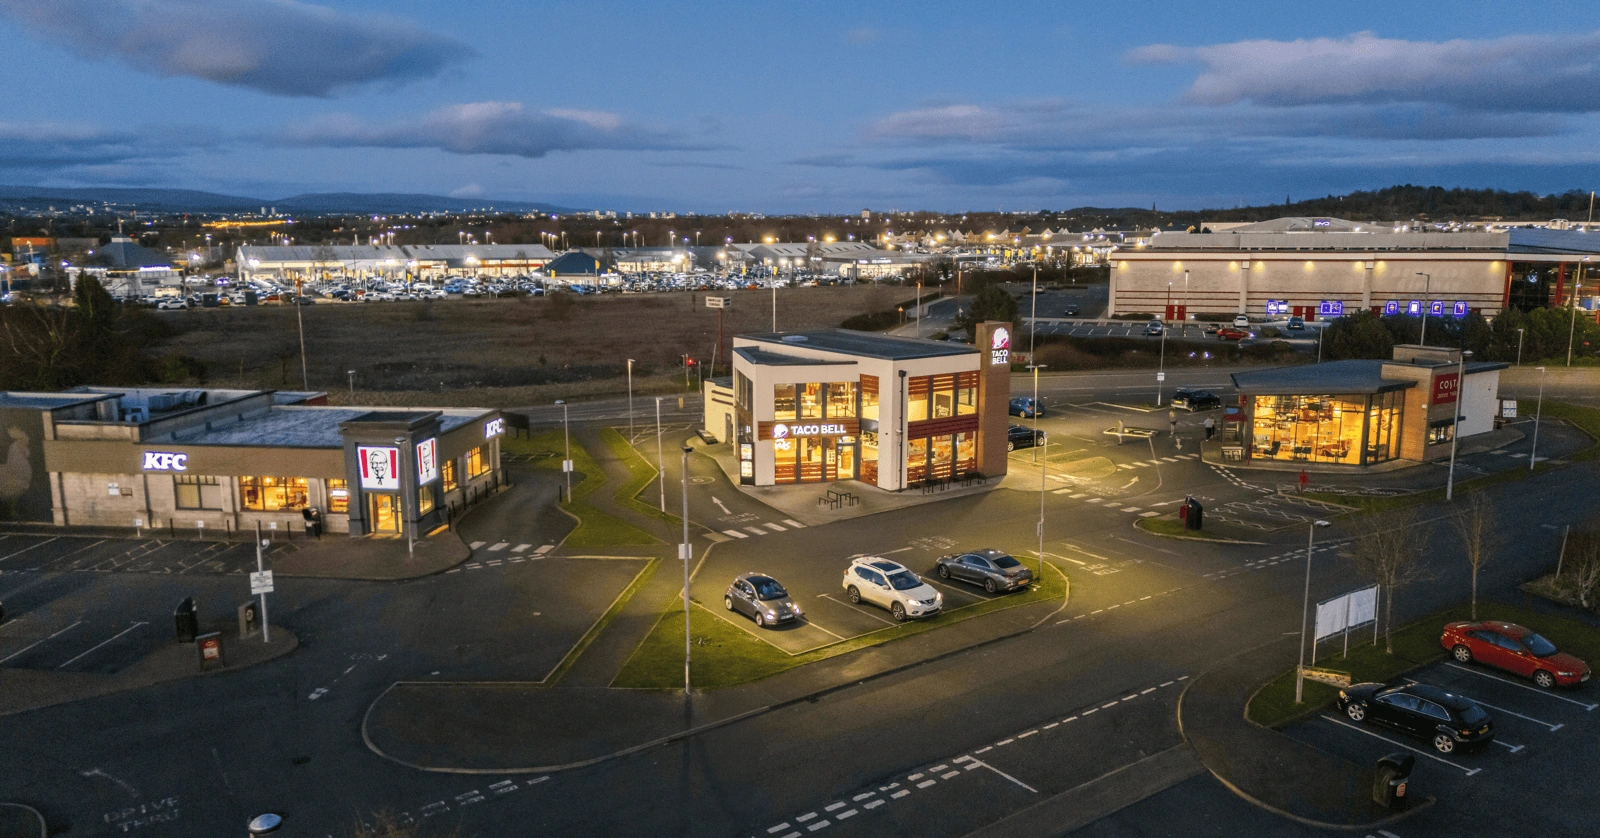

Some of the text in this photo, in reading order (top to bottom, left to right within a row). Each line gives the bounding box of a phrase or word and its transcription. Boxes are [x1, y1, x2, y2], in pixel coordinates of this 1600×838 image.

[991, 349, 1009, 357] TACO
[992, 356, 1008, 365] BELL
[1440, 379, 1459, 390] COST
[486, 417, 504, 438] KFC
[790, 424, 847, 435] TACO BELL
[143, 452, 187, 471] KFC
